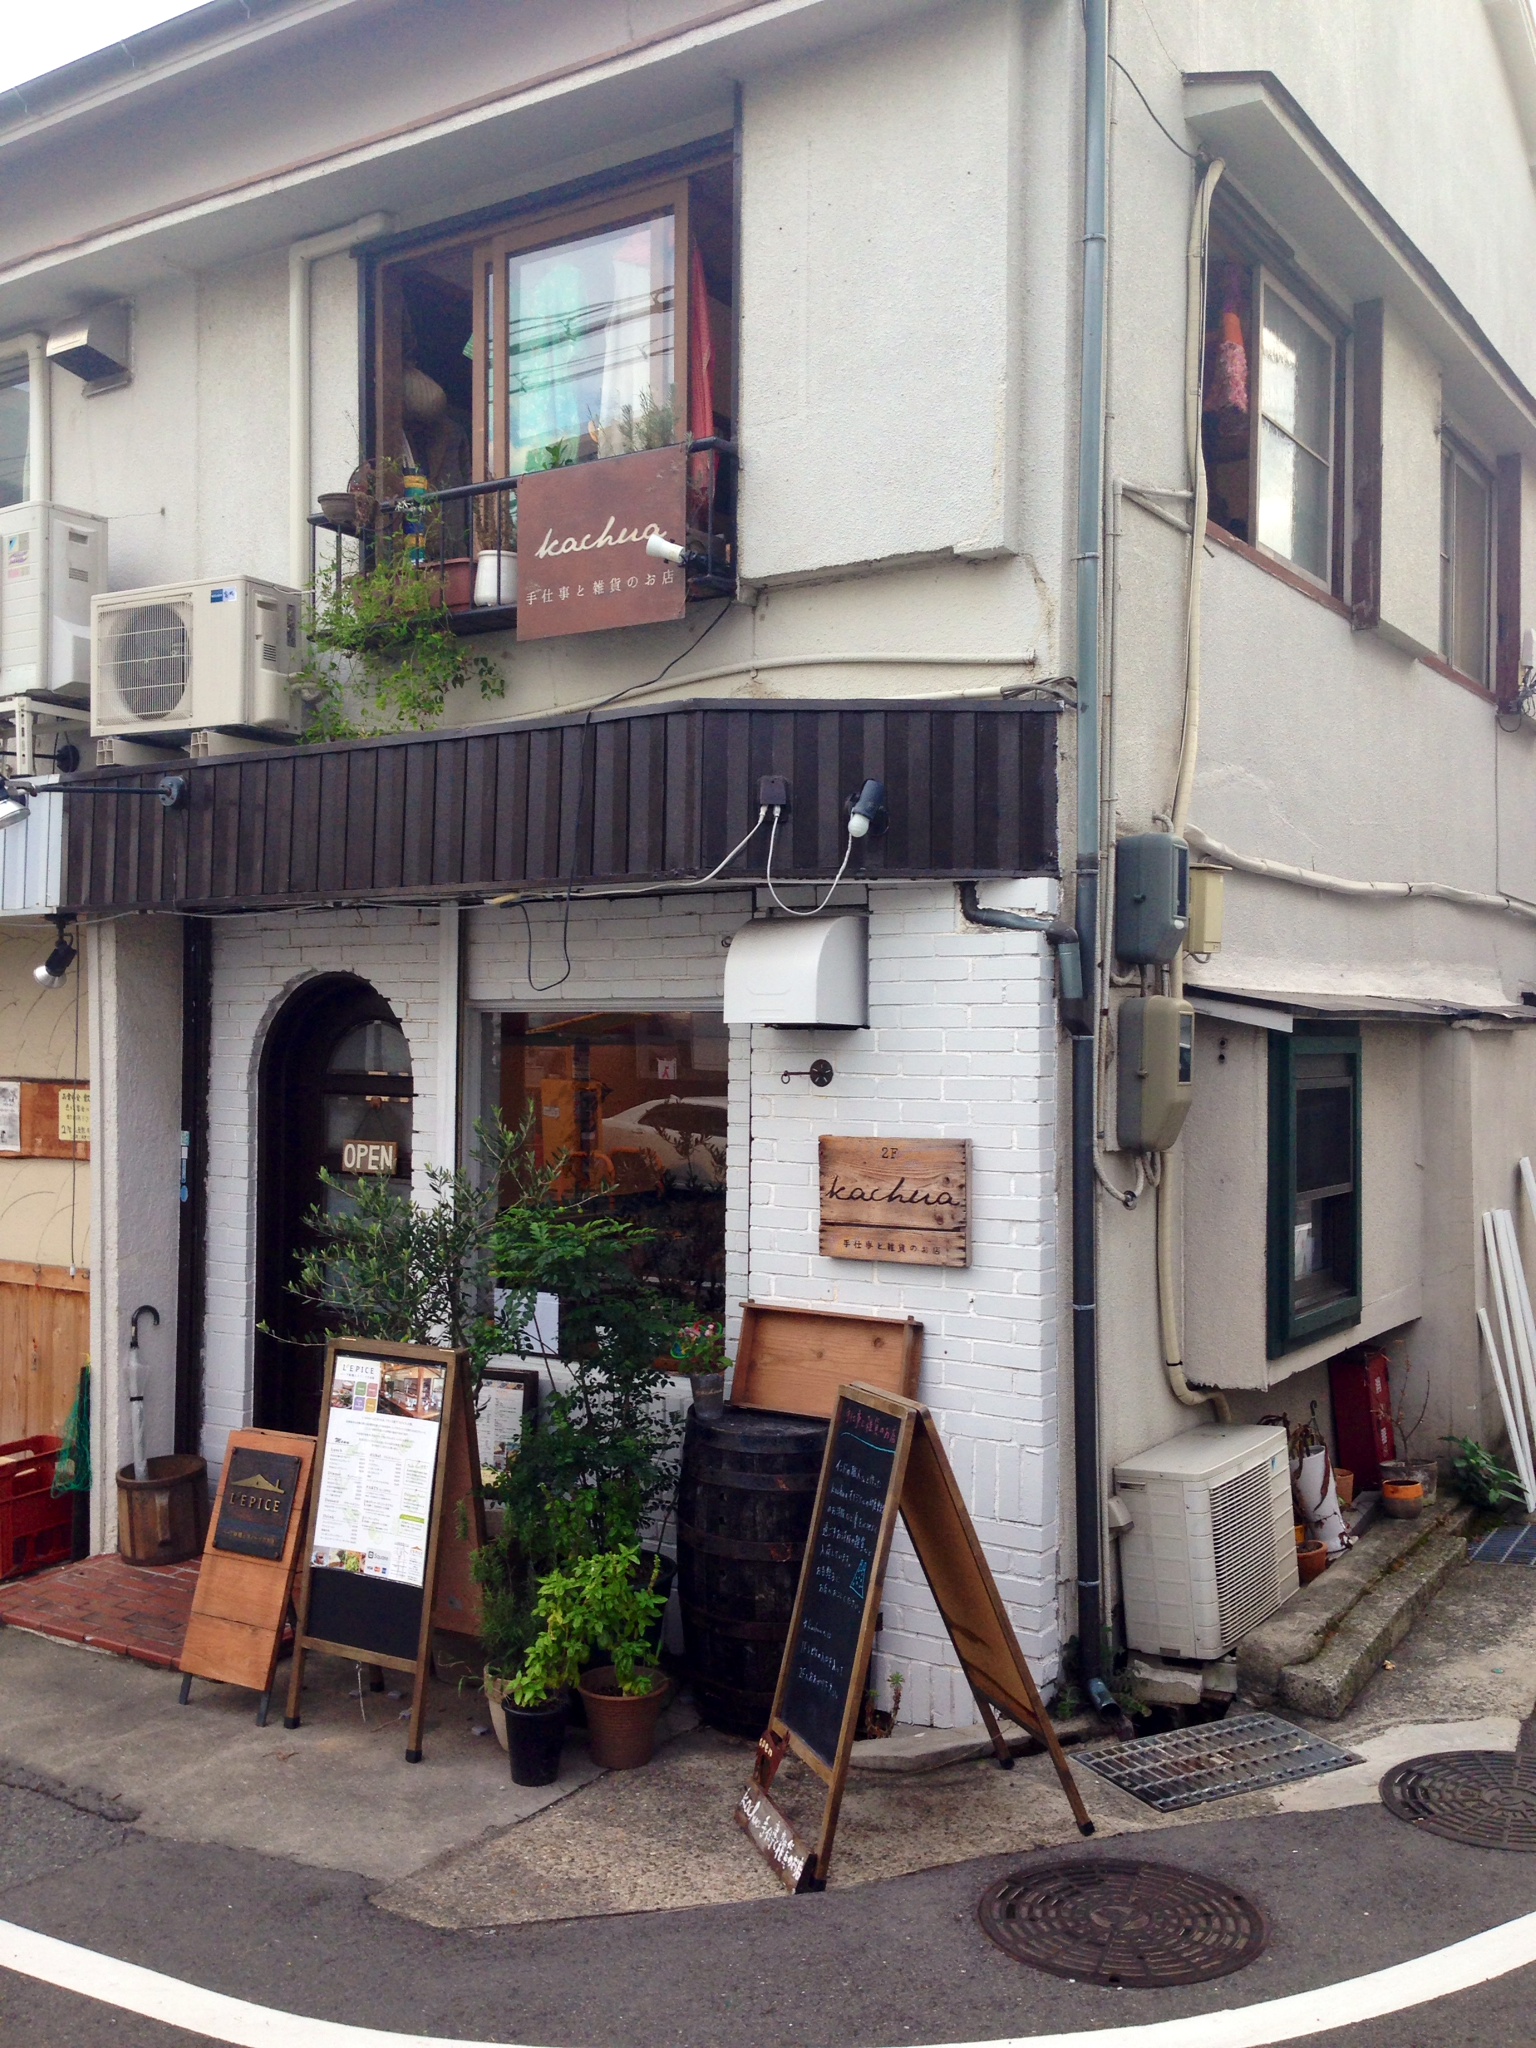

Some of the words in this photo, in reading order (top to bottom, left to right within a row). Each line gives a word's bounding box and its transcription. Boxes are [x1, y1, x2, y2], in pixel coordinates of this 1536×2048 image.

[535, 516, 667, 559] kachua
[525, 569, 674, 606] 手仕事と雑貨のお店
[343, 1143, 393, 1171] OPEN
[881, 1146, 899, 1159] 2F
[826, 1174, 961, 1206] kachua
[842, 1239, 942, 1255] 手仕事と雑貨のお店
